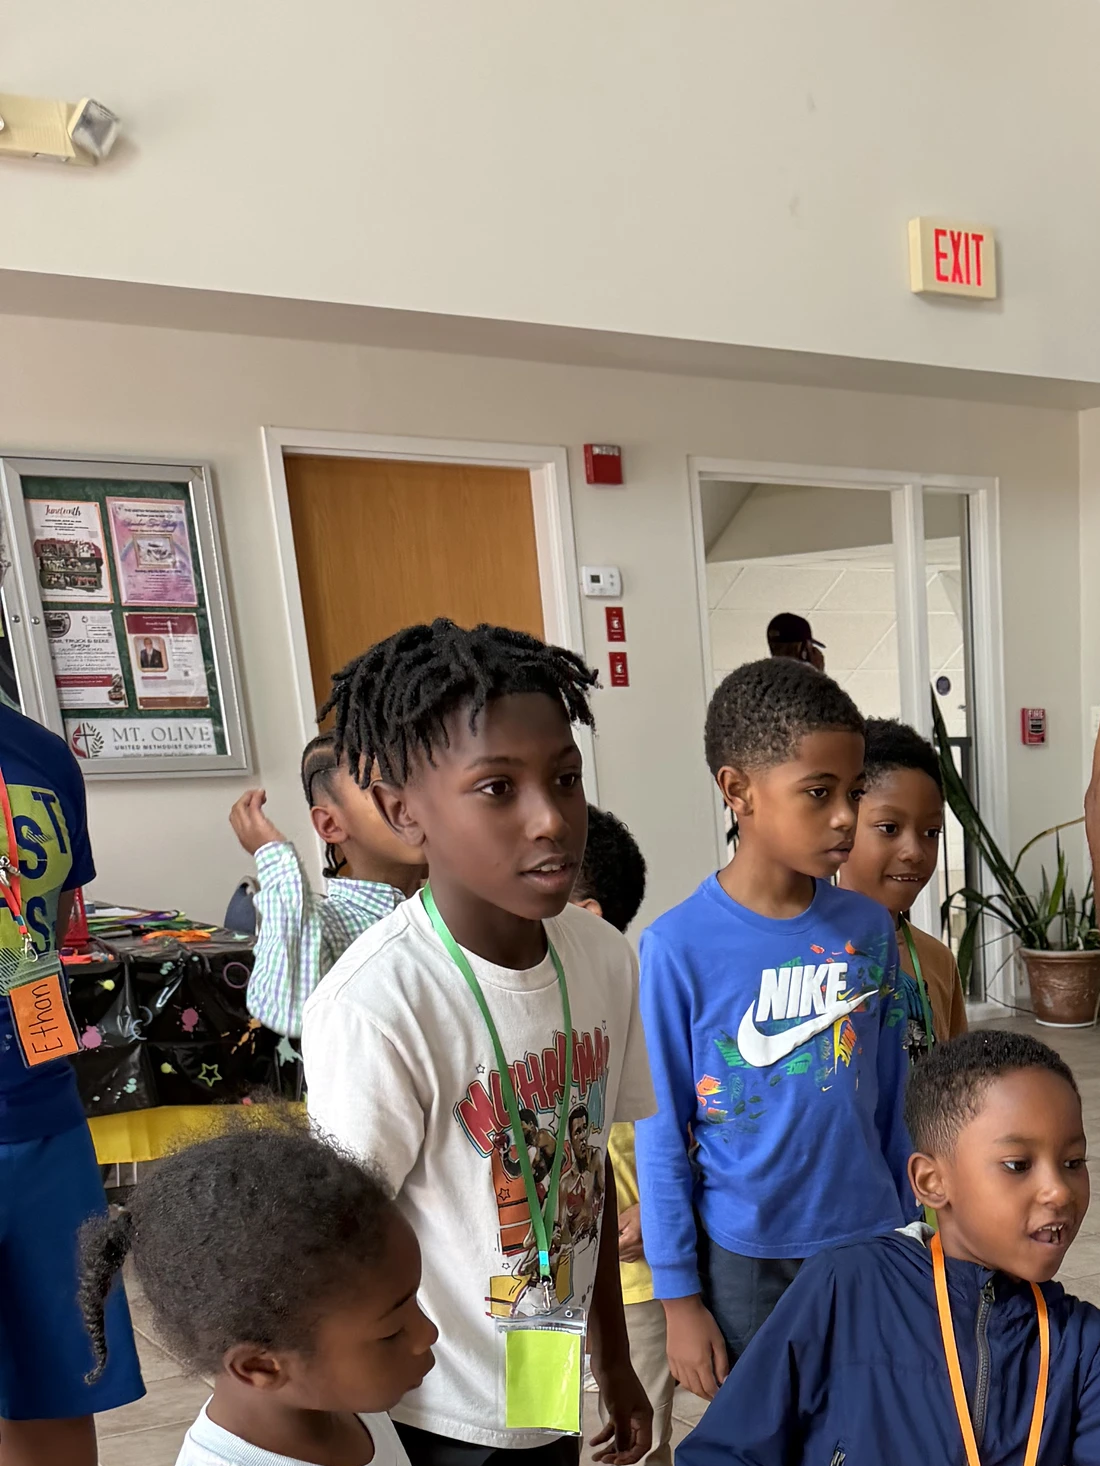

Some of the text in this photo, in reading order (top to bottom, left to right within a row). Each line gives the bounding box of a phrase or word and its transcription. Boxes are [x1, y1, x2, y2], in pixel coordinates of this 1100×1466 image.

[934, 228, 984, 287] EXIT
[112, 726, 211, 742] MT. OLIVE
[28, 983, 63, 1054] Ethan
[755, 962, 848, 1022] NIKE
